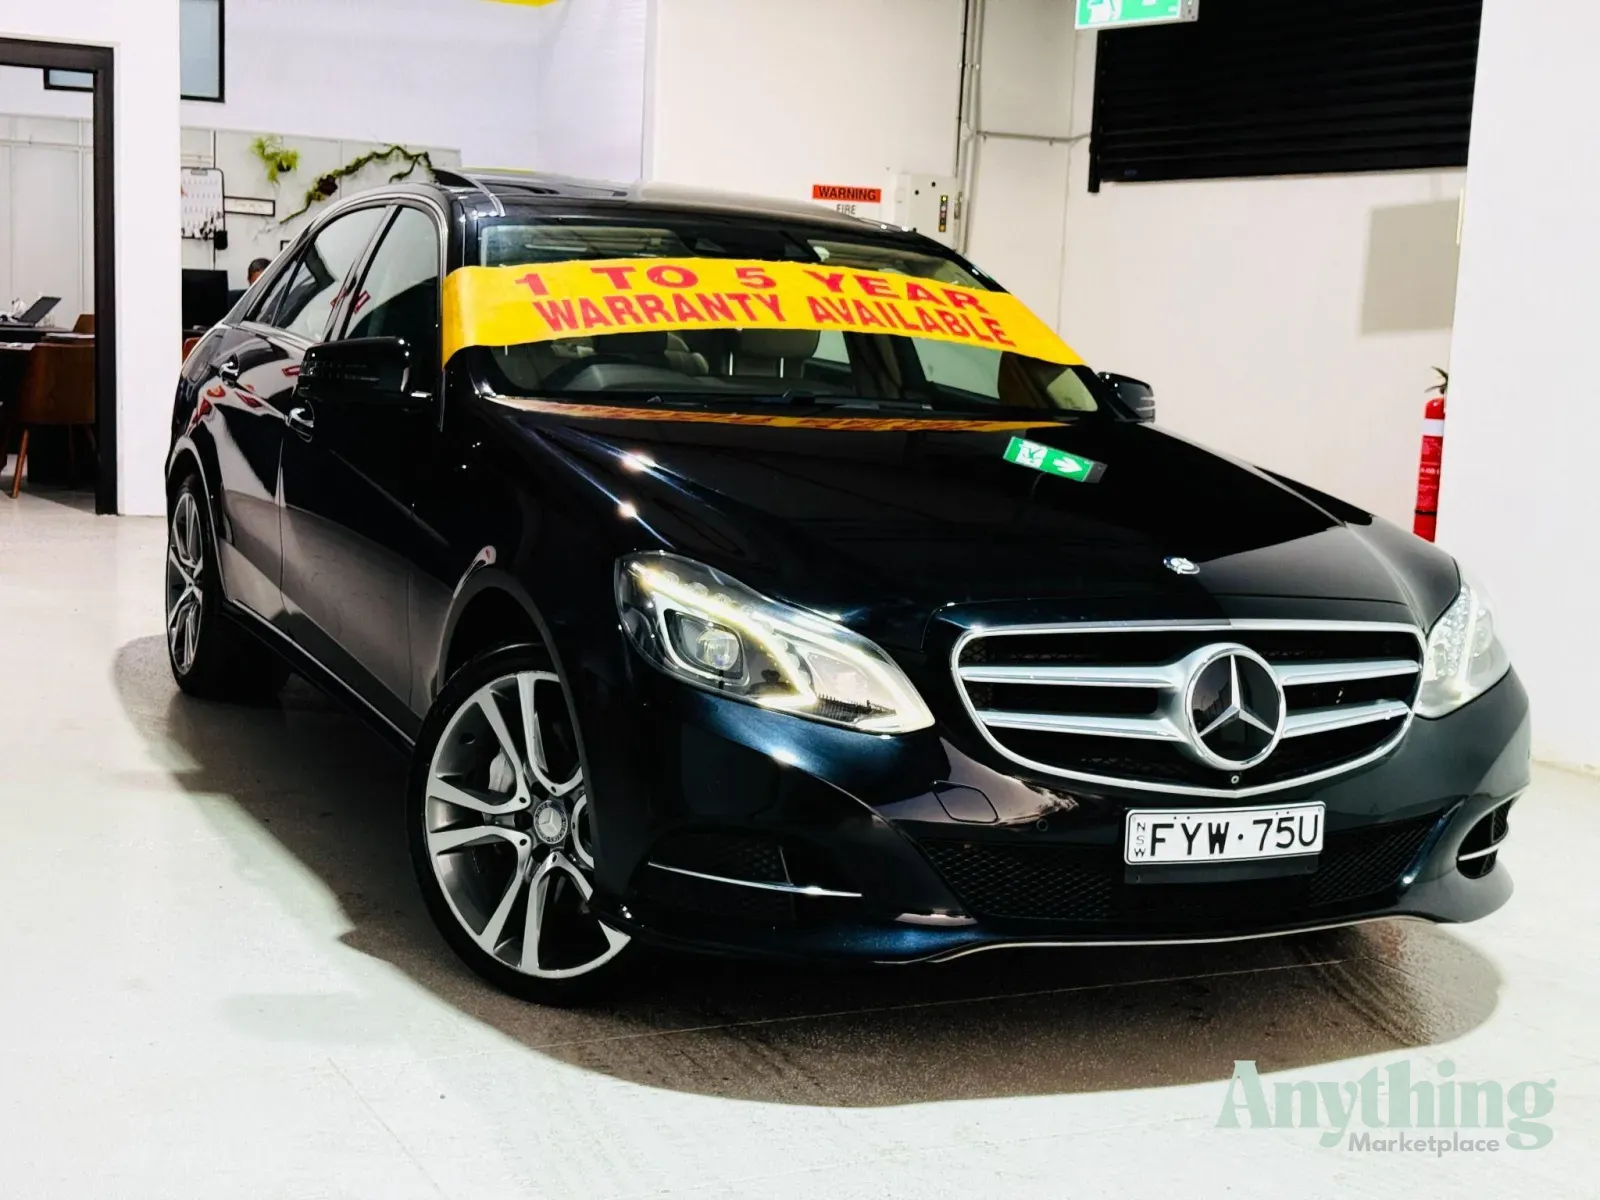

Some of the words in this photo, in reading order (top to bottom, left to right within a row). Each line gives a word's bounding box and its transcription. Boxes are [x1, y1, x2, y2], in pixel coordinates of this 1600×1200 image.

[818, 186, 877, 201] WARNING
[836, 204, 856, 216] FIRE
[515, 273, 549, 296] 1
[590, 265, 699, 290] TO
[735, 267, 777, 289] 5
[802, 270, 992, 315] YEAR
[532, 293, 787, 332] WARRANTY
[806, 296, 1017, 347] AVAILABLE
[1134, 822, 1146, 857] NSW
